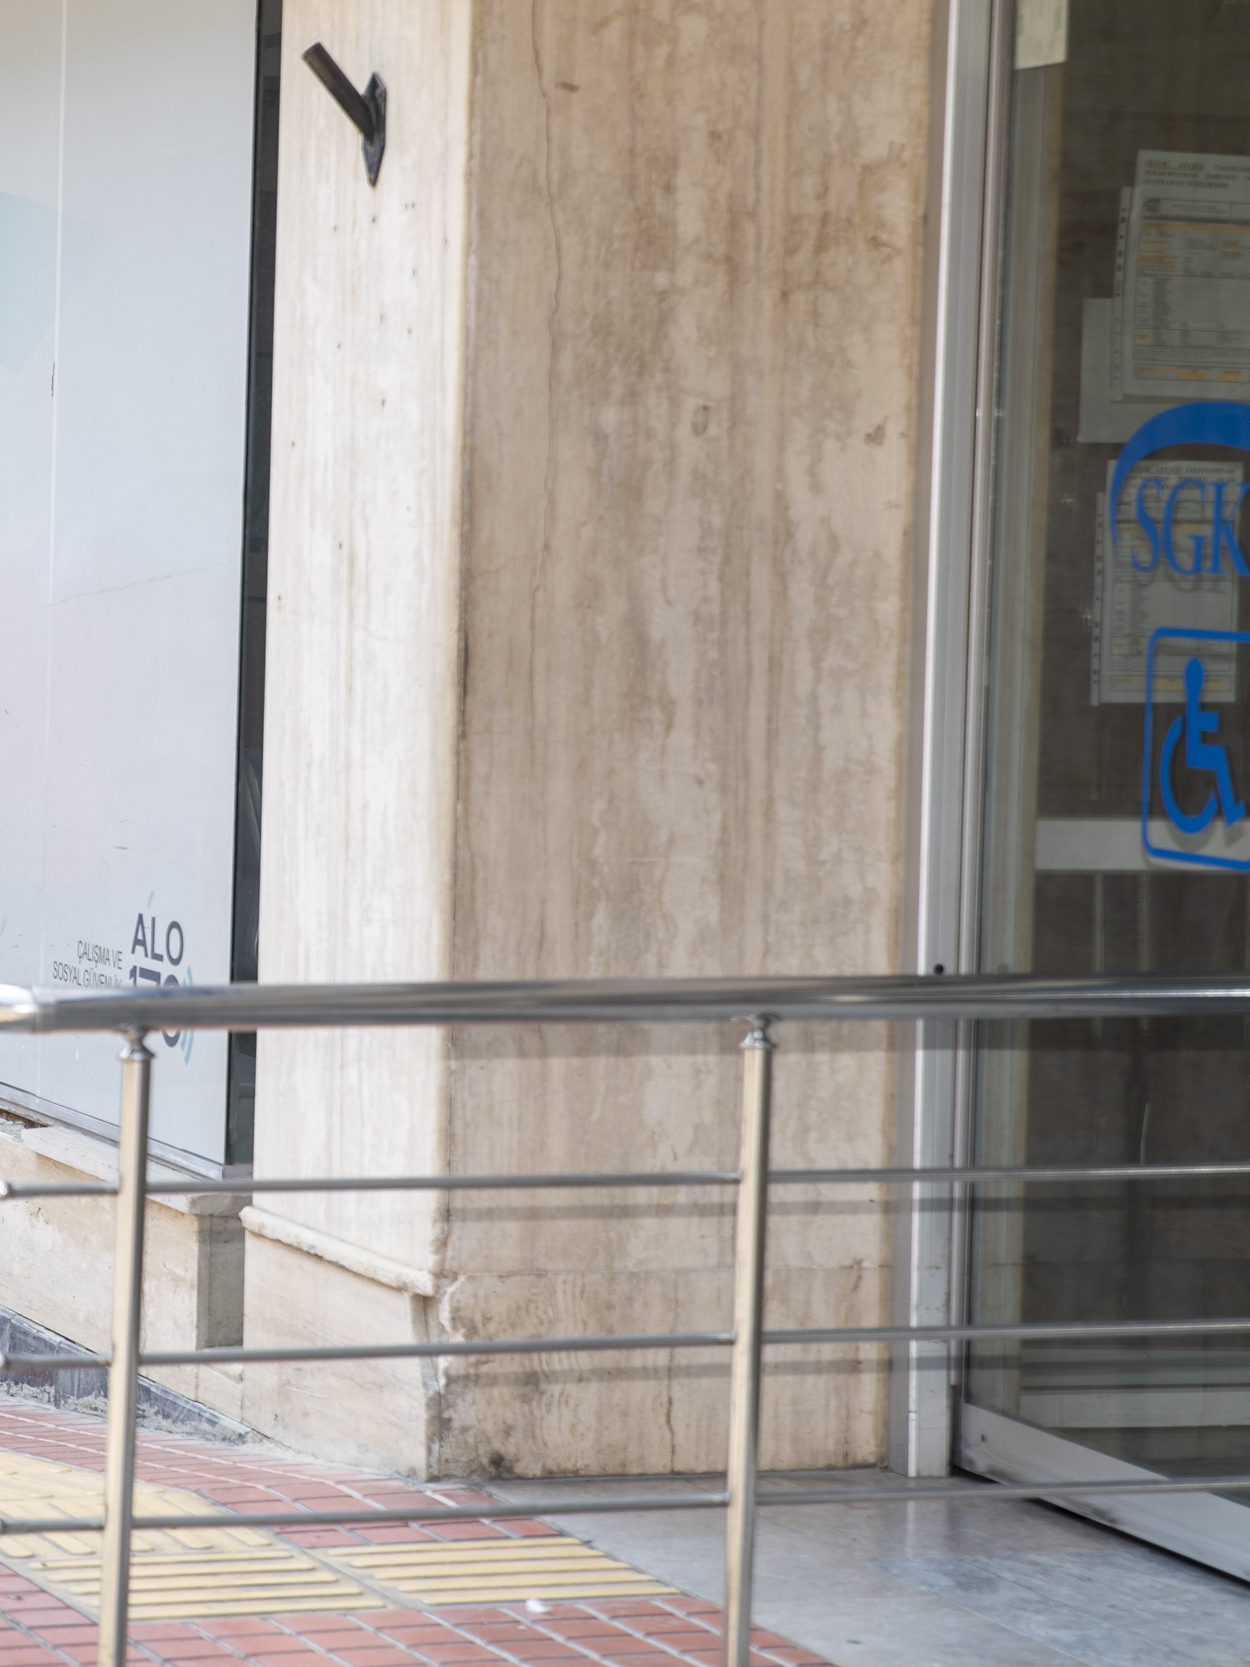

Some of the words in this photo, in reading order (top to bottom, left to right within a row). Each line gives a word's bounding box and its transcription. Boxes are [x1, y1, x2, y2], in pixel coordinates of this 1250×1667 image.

[1131, 477, 1250, 577] SGK
[76, 939, 111, 969] ÇALIŞMA
[111, 948, 123, 970] VE
[129, 912, 184, 967] ALO
[52, 960, 81, 987] SOSYAL
